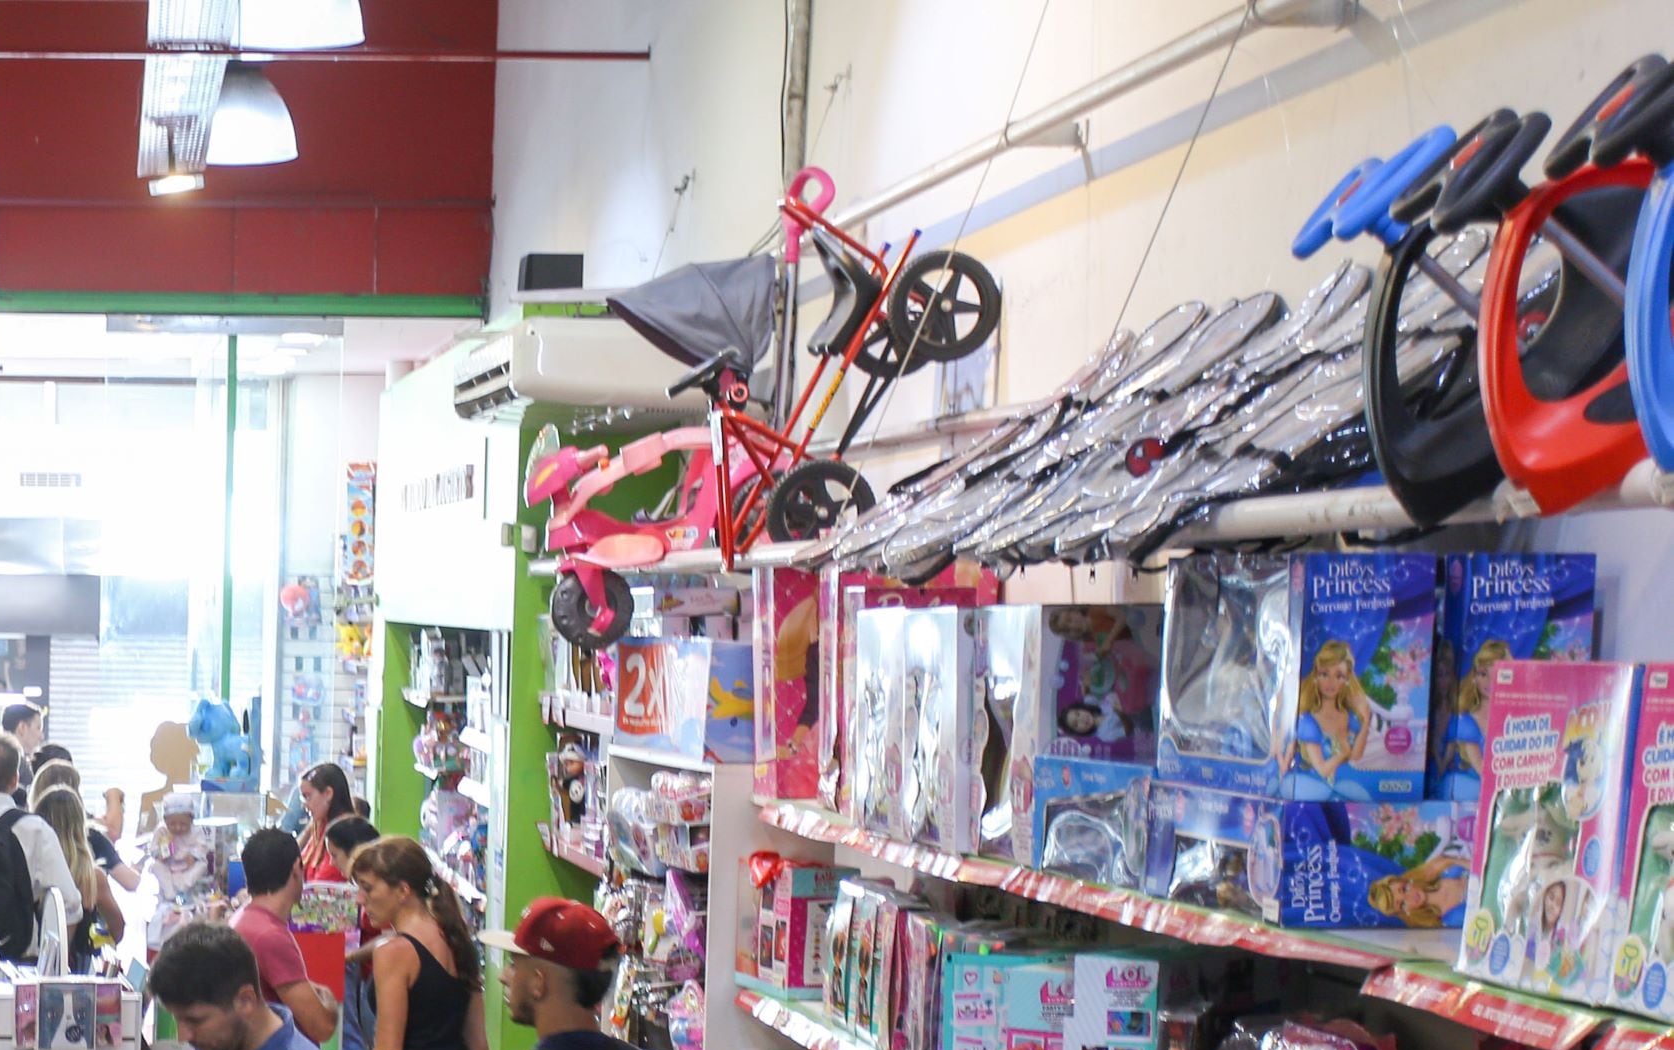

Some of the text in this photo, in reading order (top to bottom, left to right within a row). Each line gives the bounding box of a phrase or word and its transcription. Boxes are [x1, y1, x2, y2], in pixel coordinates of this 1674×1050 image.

[1312, 575, 1391, 600] Princess
[1472, 575, 1551, 600] Princess
[1512, 717, 1539, 732] HORA
[1539, 716, 1551, 731] DE
[1493, 737, 1527, 753] CUIDAR
[1528, 735, 1542, 750] DO
[1493, 755, 1515, 771] COM
[1644, 746, 1674, 765] CUID
[1304, 843, 1326, 923] Princess
